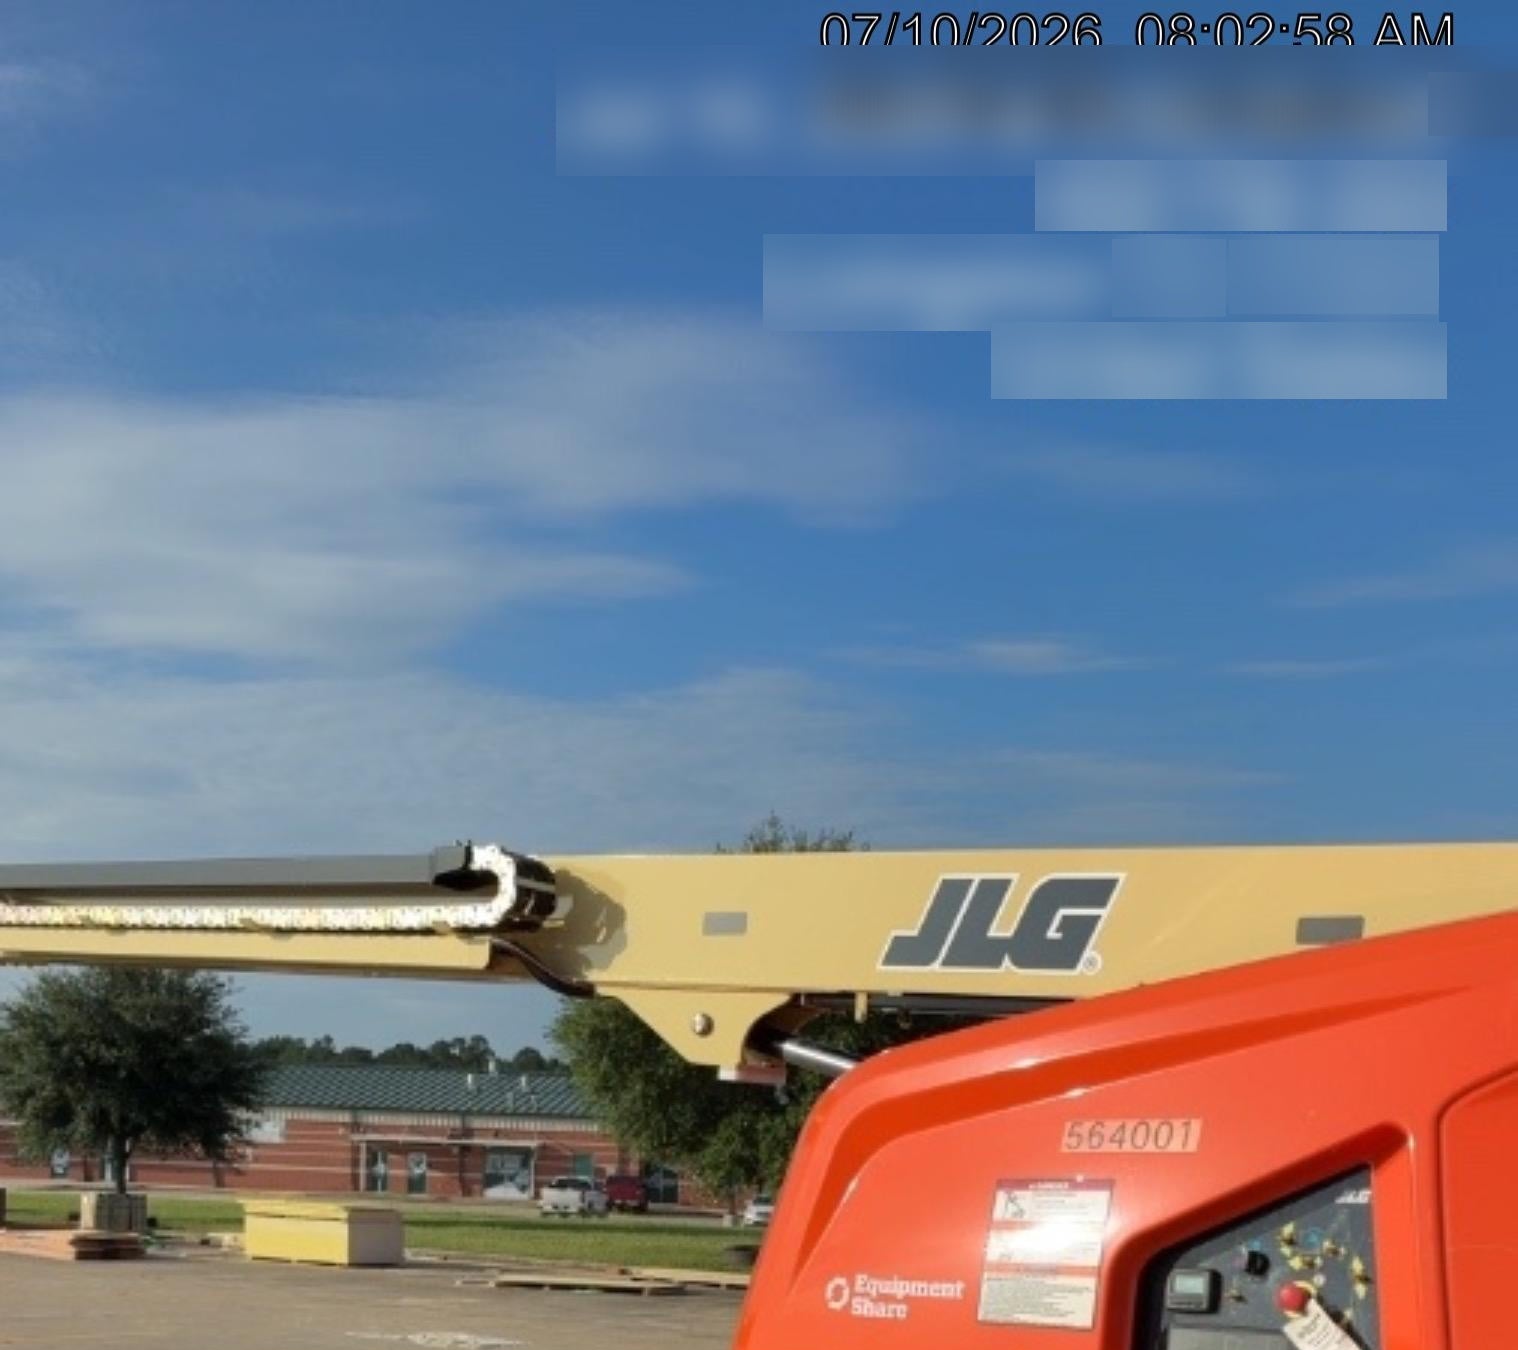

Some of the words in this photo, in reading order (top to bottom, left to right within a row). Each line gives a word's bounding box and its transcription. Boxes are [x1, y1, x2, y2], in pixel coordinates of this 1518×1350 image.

[877, 872, 1127, 976] JLG
[1066, 1120, 1193, 1150] 564001
[855, 1274, 964, 1299] Equipment
[851, 1297, 908, 1319] Share
